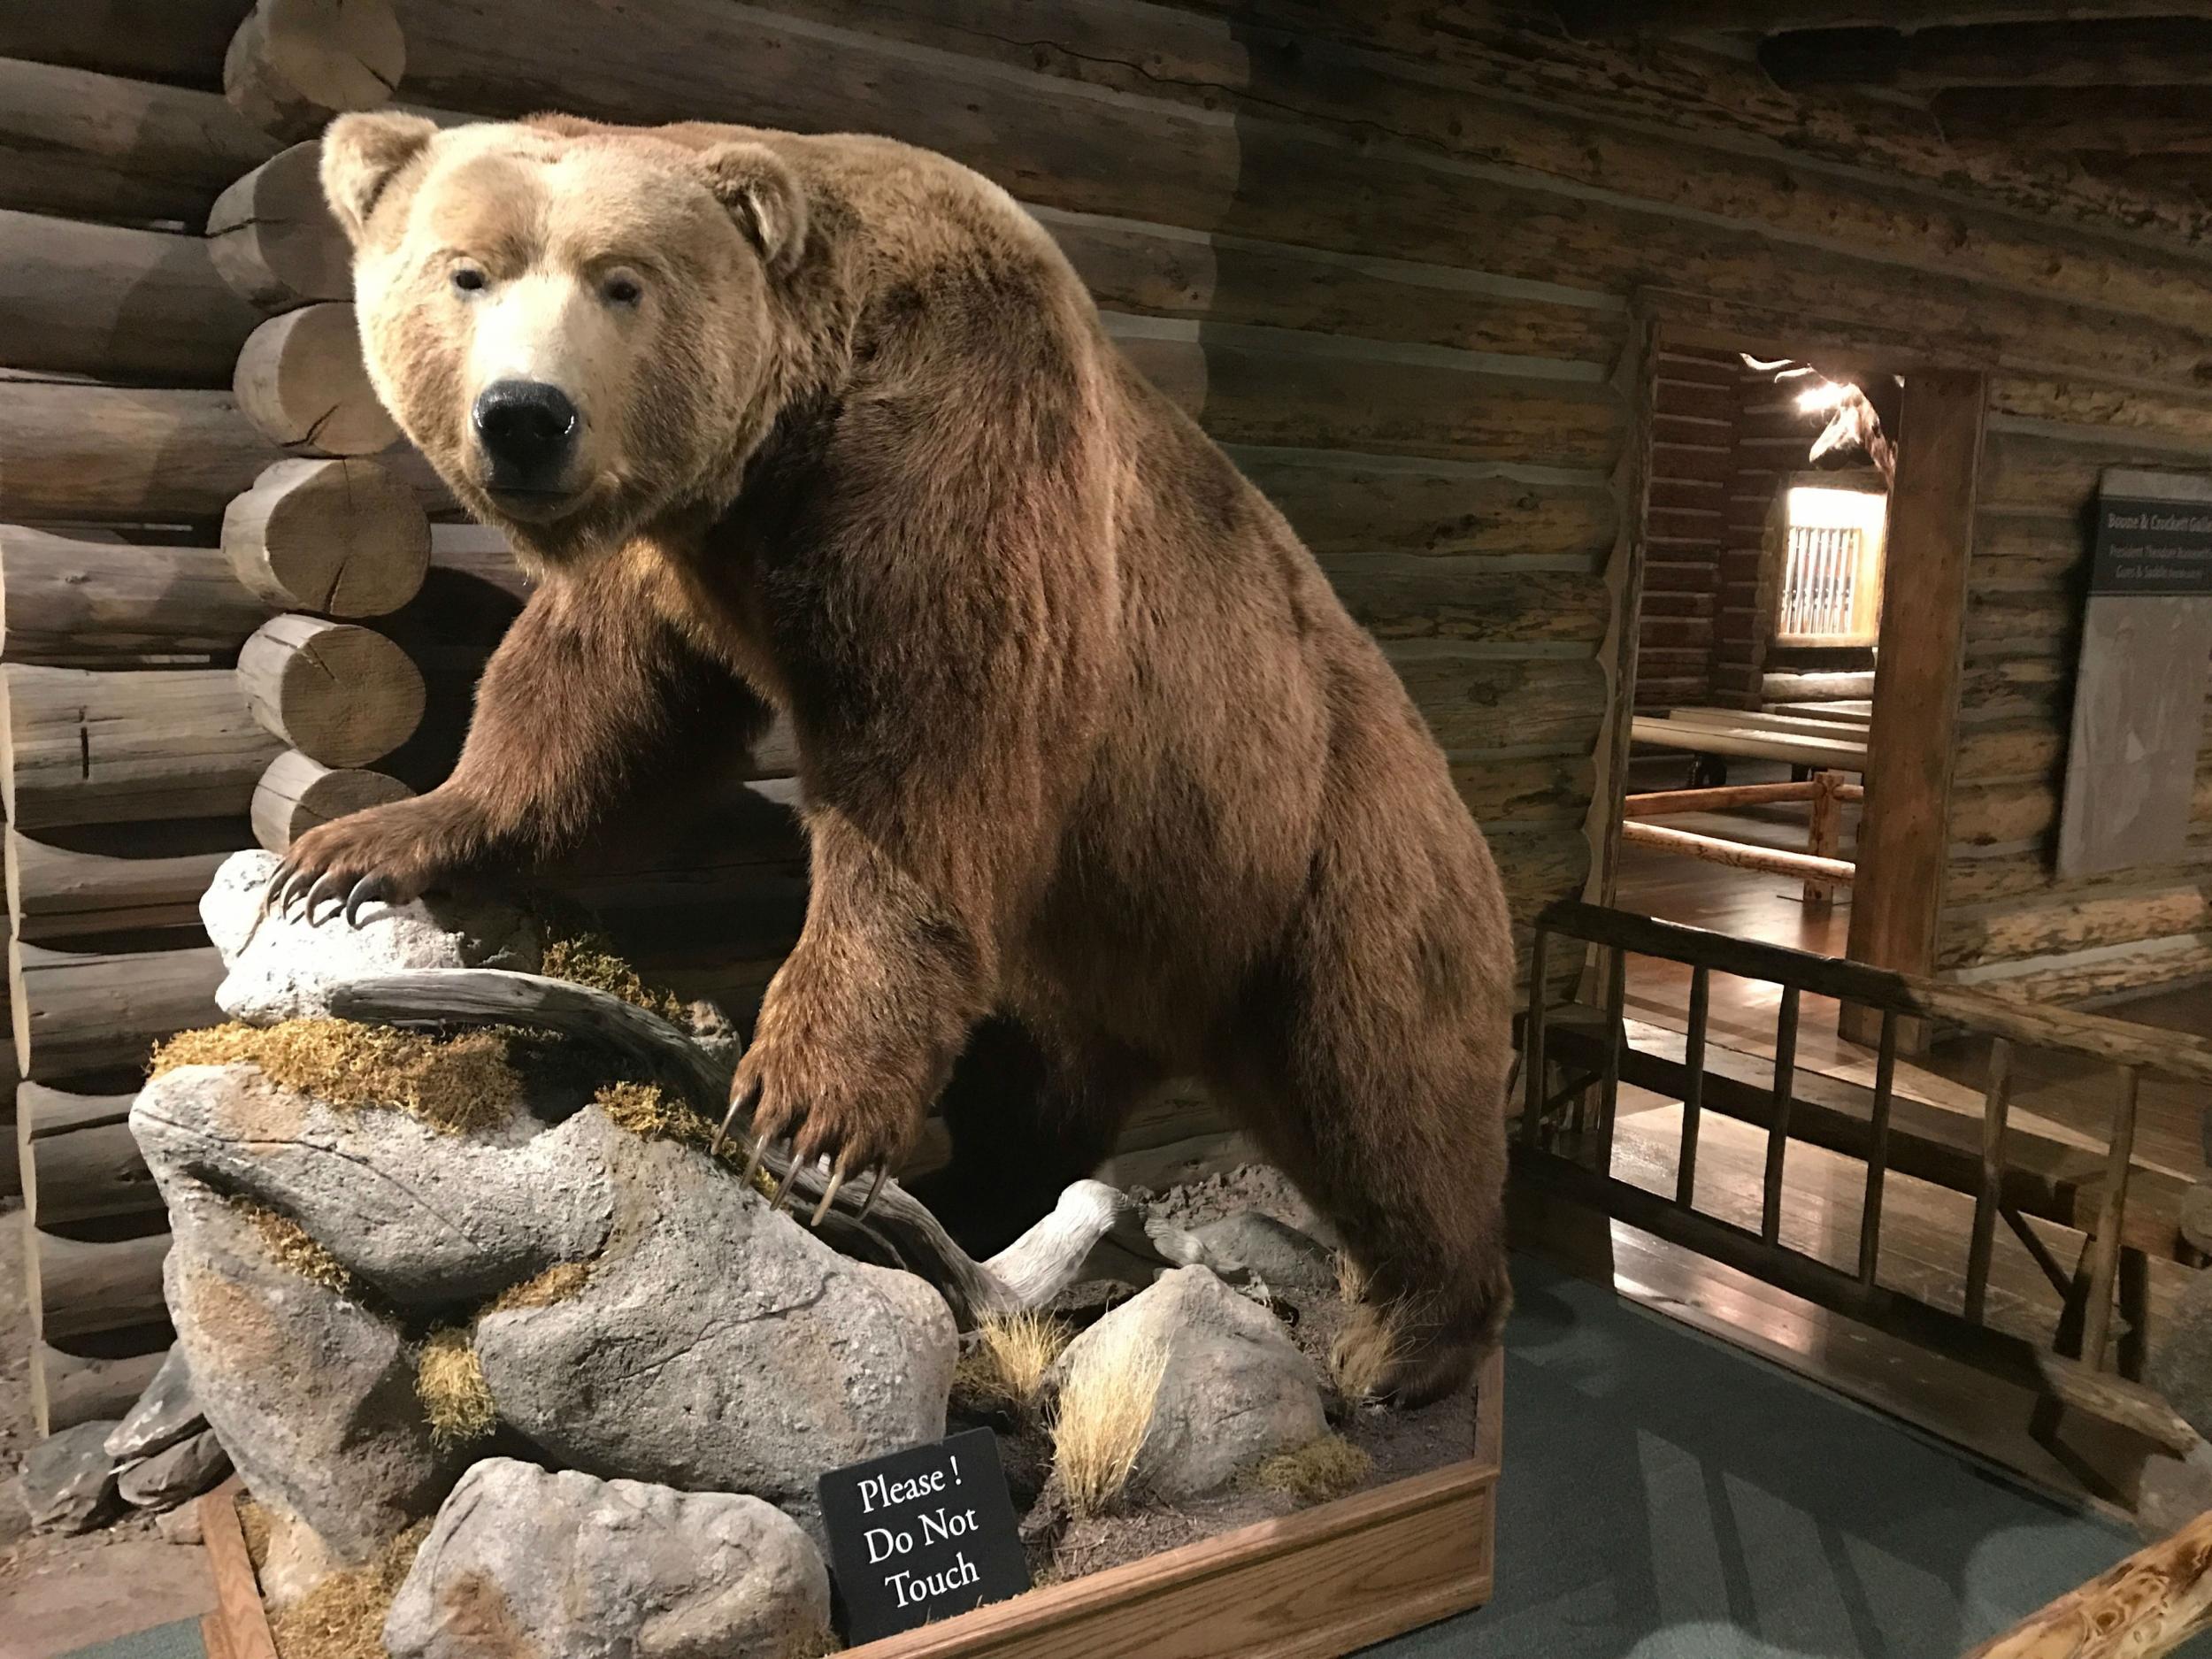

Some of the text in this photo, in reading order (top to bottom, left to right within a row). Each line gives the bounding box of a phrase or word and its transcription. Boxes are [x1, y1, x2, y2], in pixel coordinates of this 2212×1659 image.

[857, 1455, 961, 1514] Please !
[864, 1508, 979, 1563] Do Not
[884, 1551, 980, 1609] Touch
